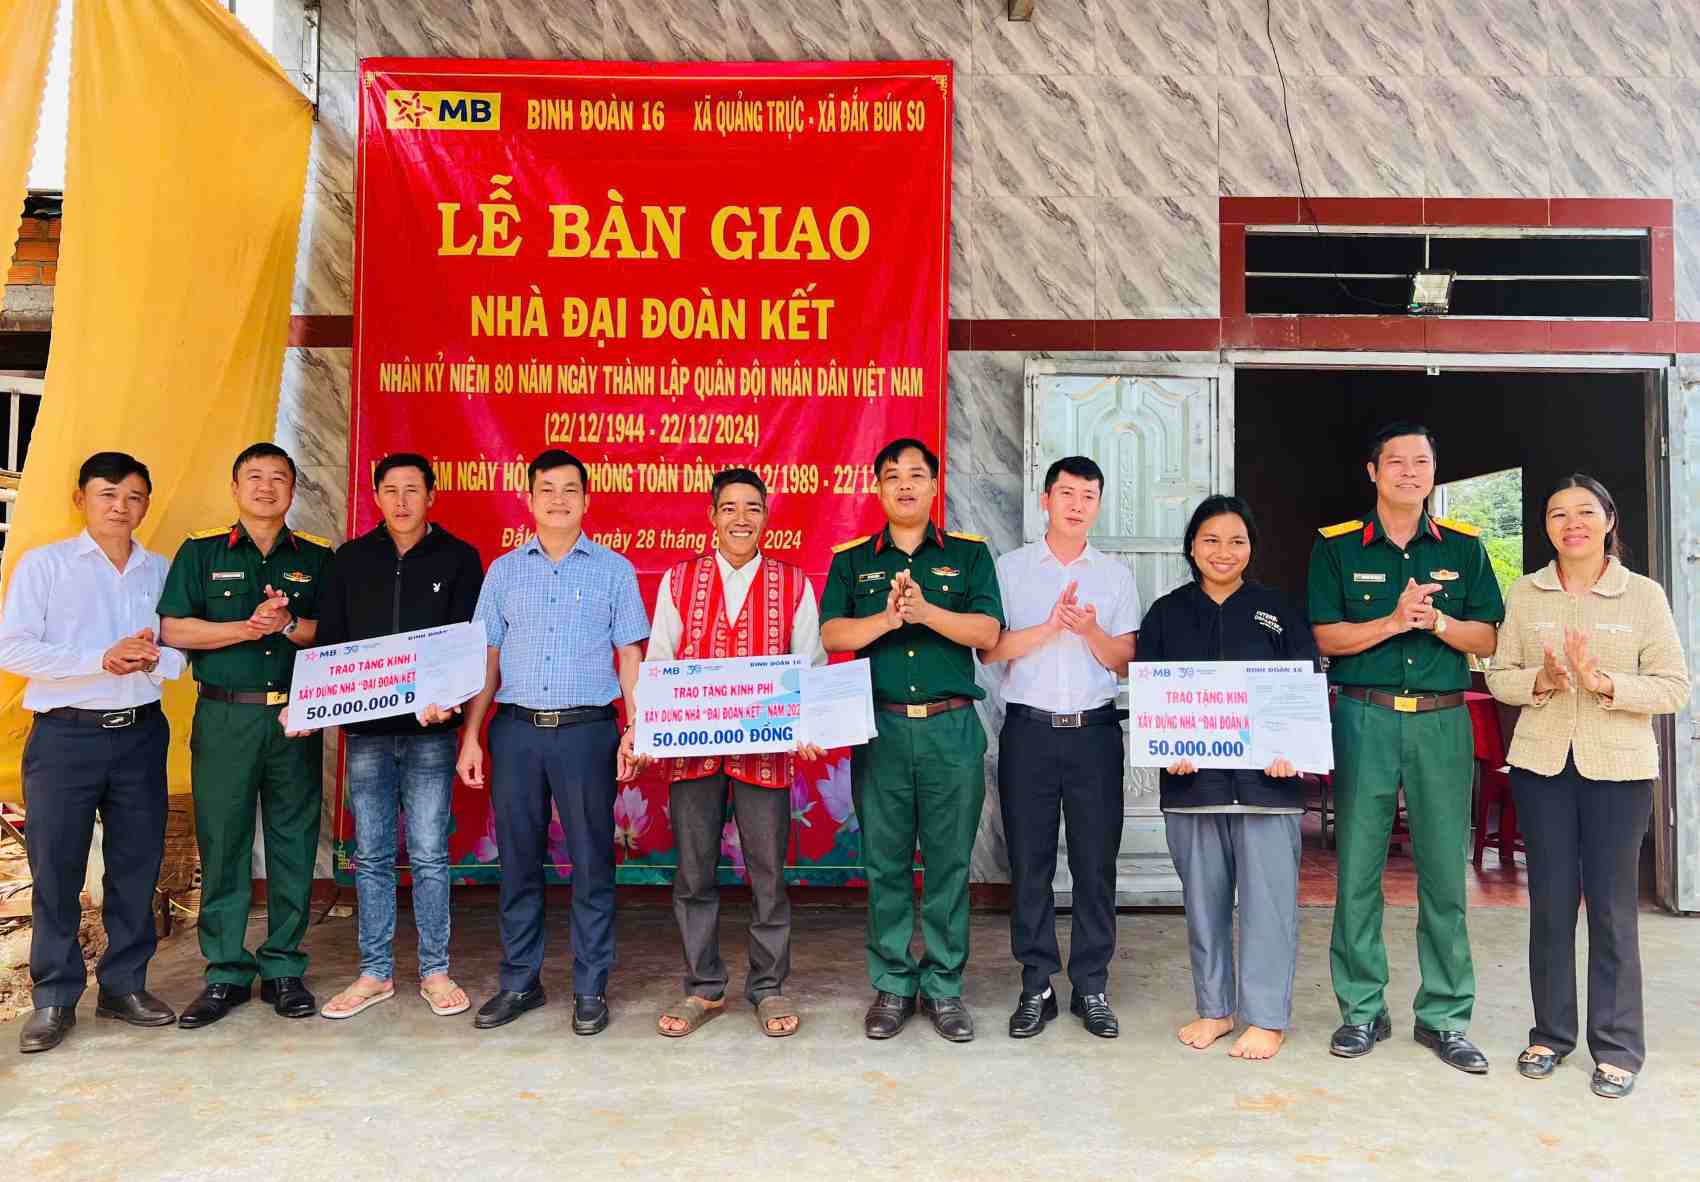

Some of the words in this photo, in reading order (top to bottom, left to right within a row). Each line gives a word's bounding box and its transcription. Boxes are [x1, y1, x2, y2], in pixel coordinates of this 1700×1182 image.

[439, 99, 492, 122] MB
[528, 99, 573, 130] BINH
[580, 93, 633, 130] ĐOÀN
[642, 101, 664, 130] 16
[694, 95, 712, 131] XÃ
[716, 91, 762, 136] QUẢNG
[766, 95, 805, 139] TRỰC
[818, 94, 836, 132] XÃ
[840, 87, 869, 132] ĐẮK
[874, 93, 902, 132] BÚK
[907, 100, 925, 132] SO
[438, 175, 522, 257] LỄ
[548, 189, 686, 259] BÀN
[711, 206, 870, 261] GIAO
[471, 285, 548, 337] NHÀ
[562, 297, 627, 348] ĐẠI
[641, 288, 746, 340] ĐOÀN
[761, 283, 835, 341] KẾT
[380, 357, 421, 392] NHÂN
[425, 352, 444, 392] KỶ
[450, 356, 489, 400] NIỆM
[495, 364, 513, 393] 80
[519, 358, 552, 394] NĂM
[558, 357, 598, 395] NGÀY
[603, 358, 654, 396] THÀNH
[660, 358, 690, 402] LẬP
[694, 359, 735, 401] QUÂN
[740, 359, 766, 403] ĐỘI
[771, 360, 812, 397] NHÂN
[817, 359, 848, 397] DÂN
[853, 360, 886, 404] VIỆT
[891, 367, 923, 397] NAM
[545, 412, 645, 446] (22/12/1944
[660, 413, 759, 448] 22/12/2024)
[433, 456, 452, 491] ĂM
[457, 454, 498, 491] NGÀY
[637, 455, 678, 493] TOÀN
[683, 455, 714, 493] DÂN
[592, 528, 632, 554] ngày
[636, 529, 656, 549] 28
[660, 529, 707, 554] tháng
[764, 530, 801, 549] 2024
[320, 649, 336, 658] MB
[329, 664, 355, 676] TRAO
[387, 655, 410, 665] KINH
[662, 666, 680, 675] MB
[1152, 668, 1171, 677] MB
[673, 686, 699, 699] TRAO
[730, 683, 753, 696] KINH
[1166, 691, 1193, 704] TRAO
[306, 694, 399, 719] 50.000.000
[653, 729, 744, 747] 50.000.000
[750, 722, 793, 743] ĐỒNG
[1148, 740, 1244, 757] 50.000.000
